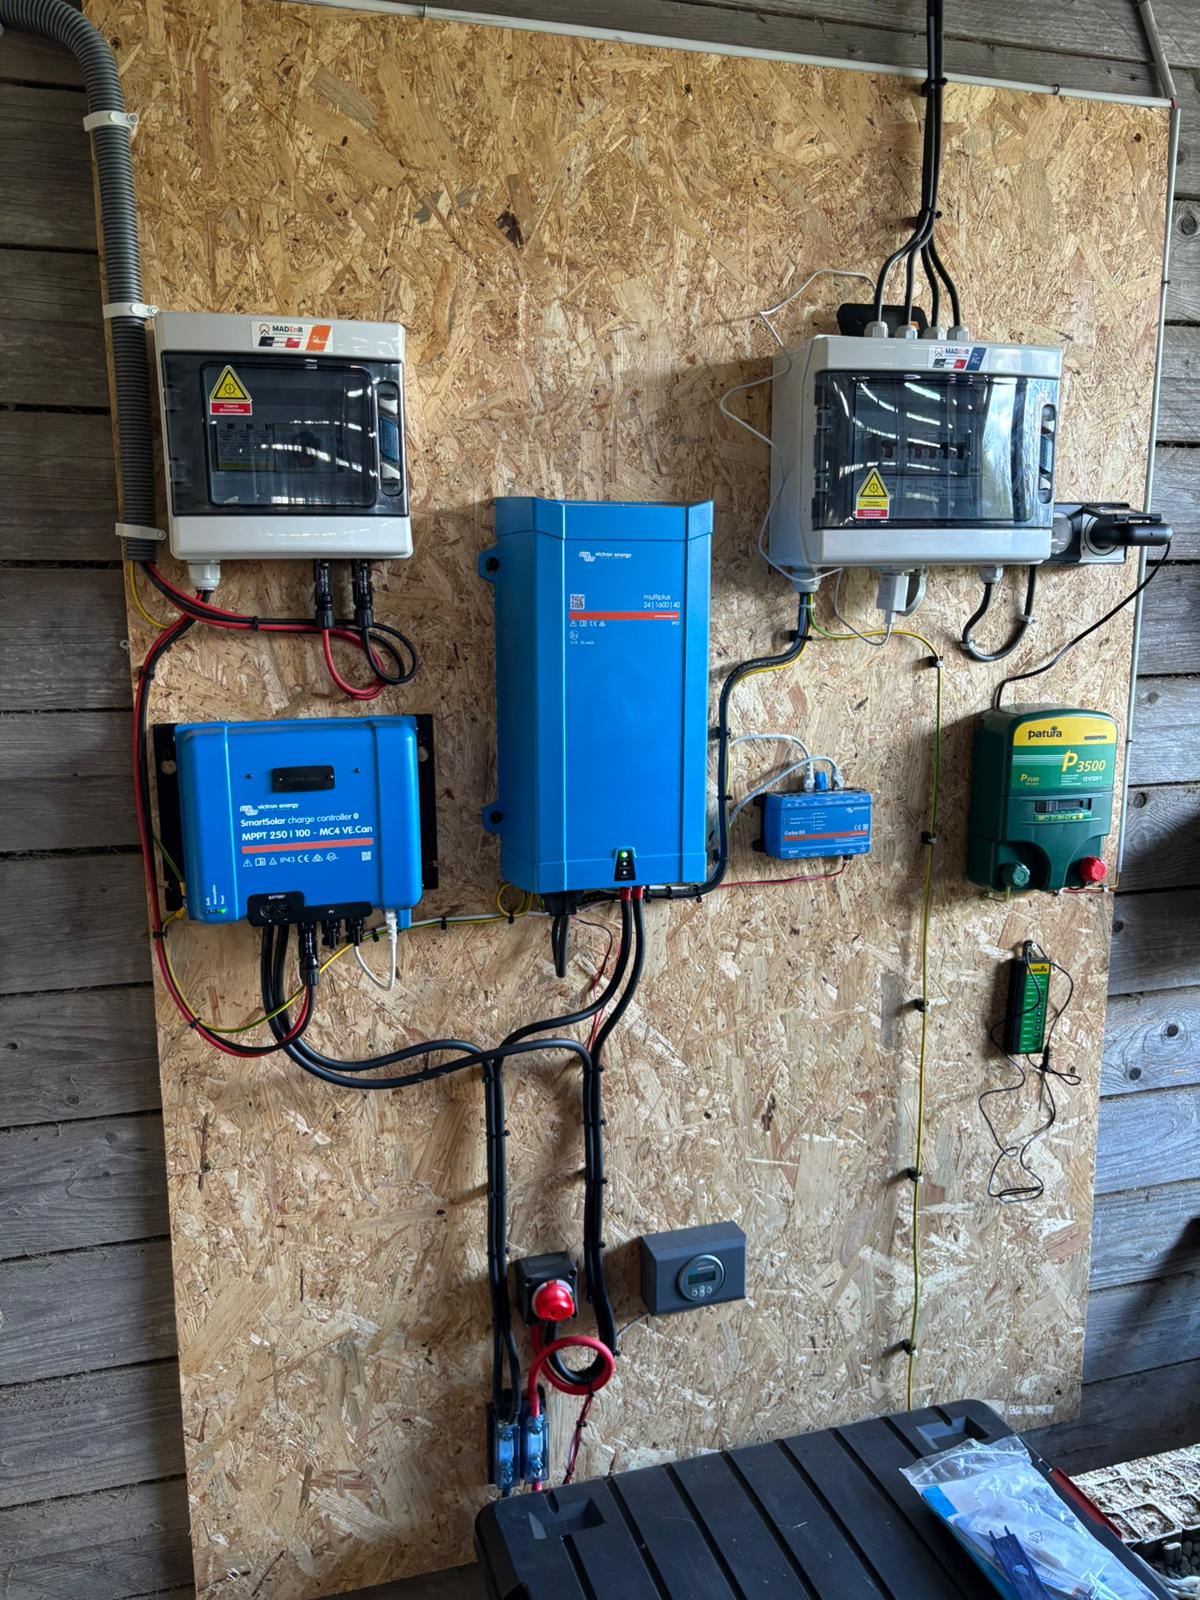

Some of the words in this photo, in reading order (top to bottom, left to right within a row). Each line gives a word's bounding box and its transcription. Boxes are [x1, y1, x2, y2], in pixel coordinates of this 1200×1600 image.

[643, 594, 671, 602] multiplus
[1028, 729, 1062, 740] patura
[240, 817, 286, 828] SmartSolar
[287, 815, 315, 824] charge
[316, 813, 352, 823] controller
[242, 831, 267, 841] MPPT
[270, 830, 288, 839] 250
[295, 828, 311, 838] 100
[319, 827, 340, 836] MC4
[341, 825, 373, 834] VE.Can
